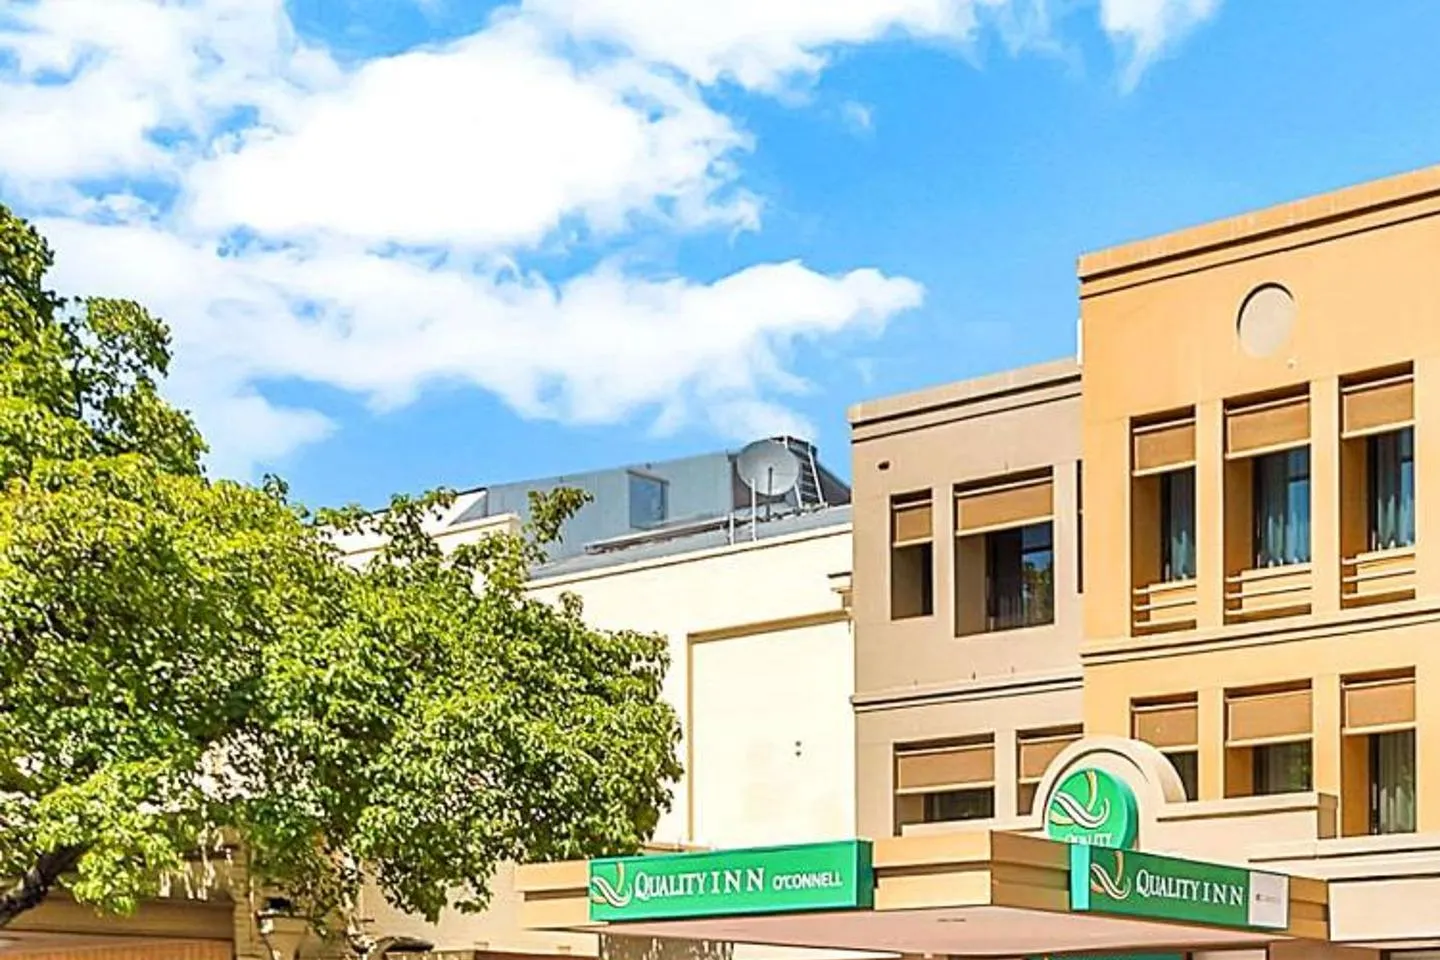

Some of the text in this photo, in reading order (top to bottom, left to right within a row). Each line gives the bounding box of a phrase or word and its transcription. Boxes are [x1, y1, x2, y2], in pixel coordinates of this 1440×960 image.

[635, 867, 843, 900] QUALITY INN O'CONNELL
[1136, 869, 1244, 906] QUALITY INN
